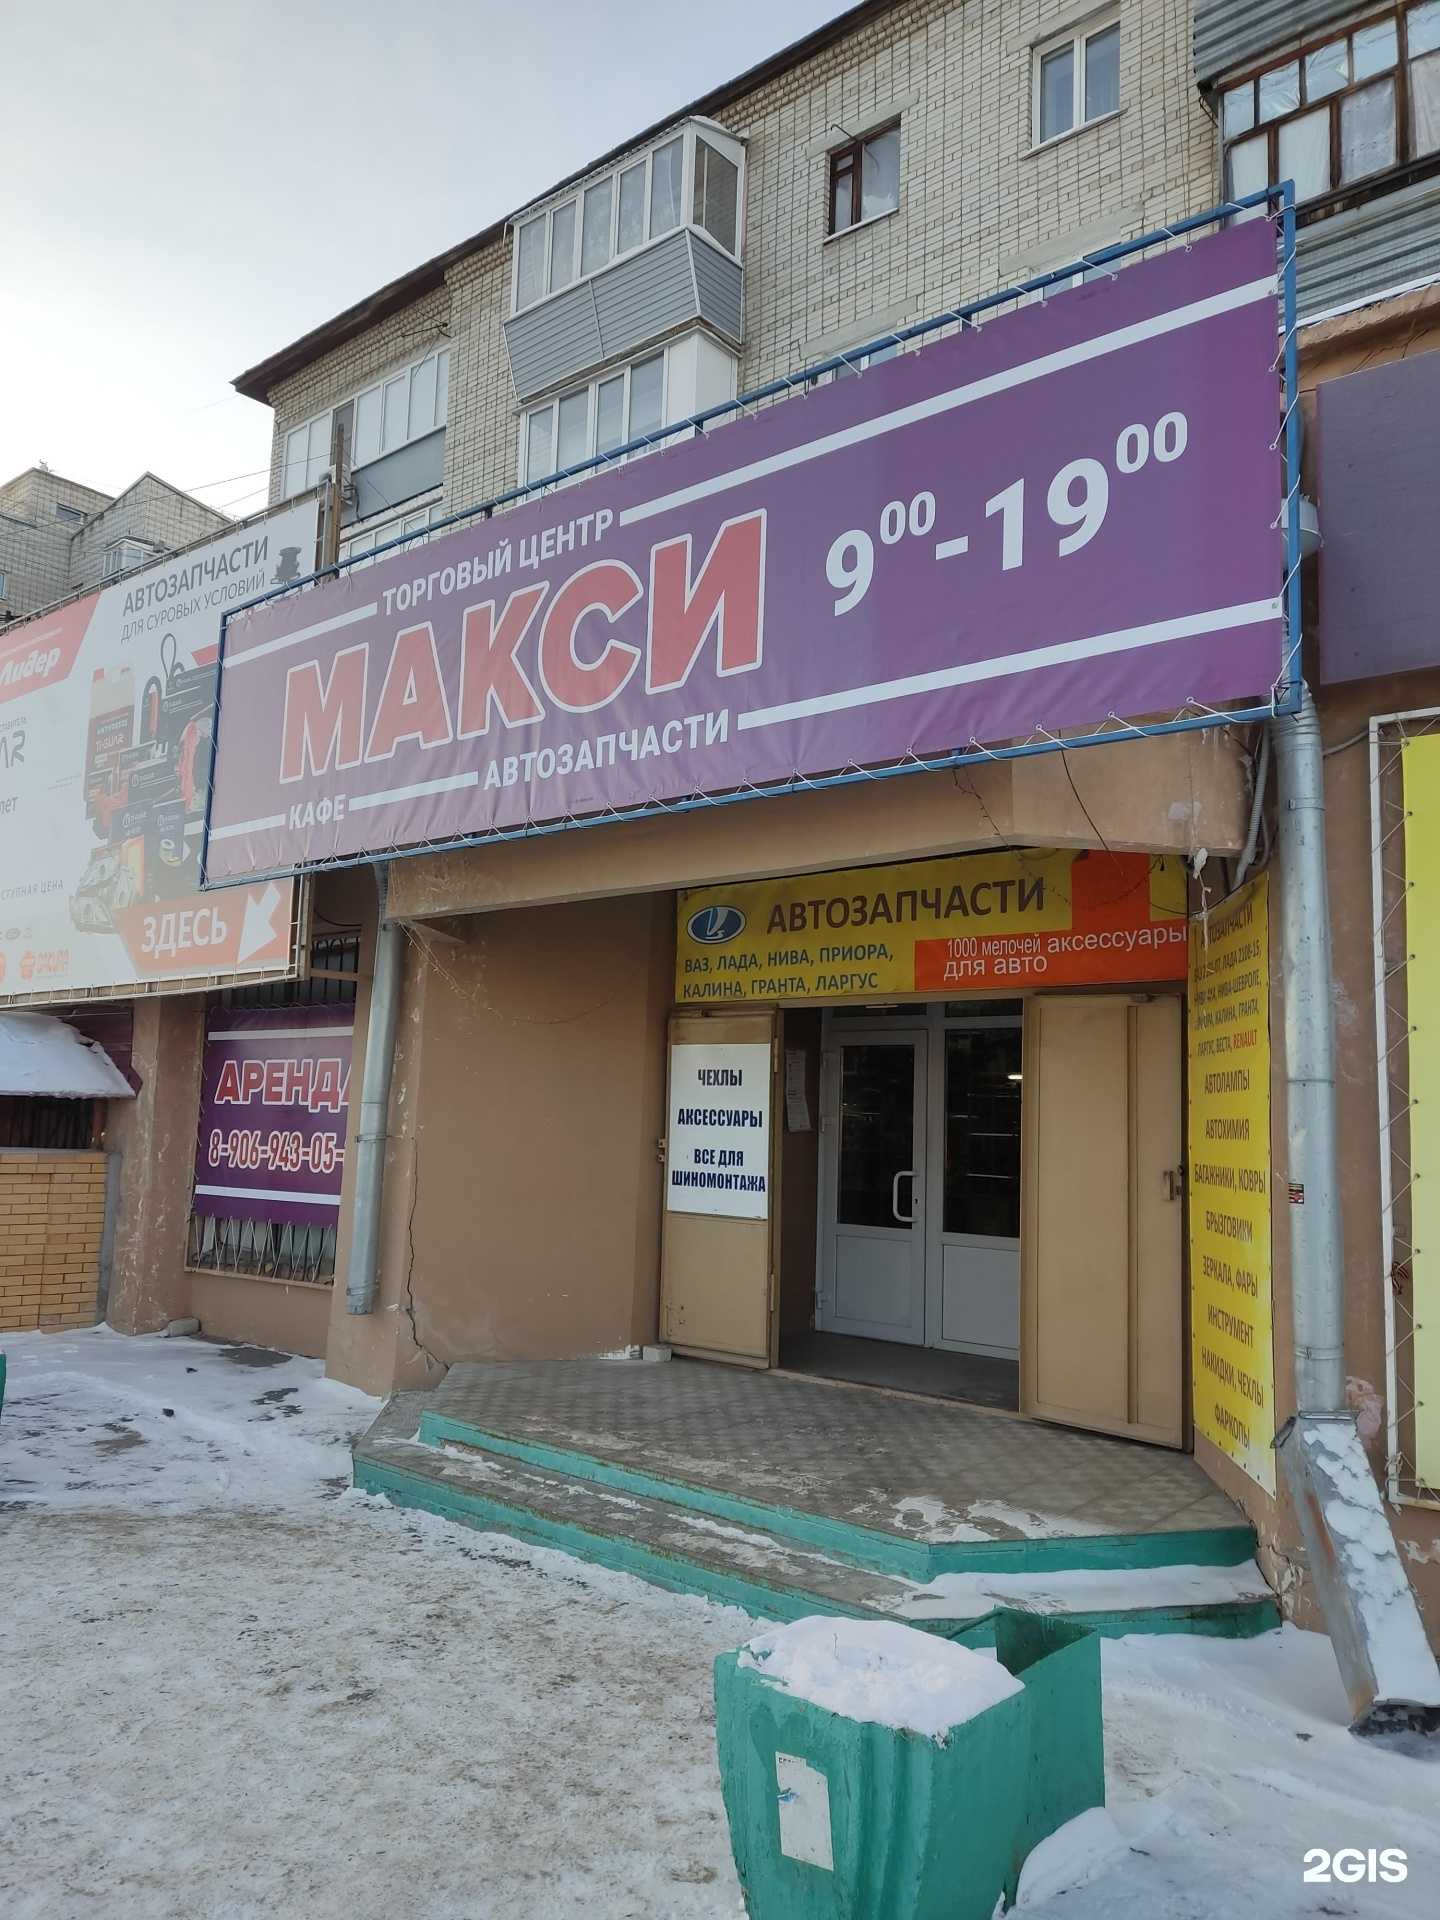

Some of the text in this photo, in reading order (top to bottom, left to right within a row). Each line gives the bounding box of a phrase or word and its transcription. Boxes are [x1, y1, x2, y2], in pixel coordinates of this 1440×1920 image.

[123, 536, 268, 616] АВТОЗАПЧАСТИ
[382, 508, 614, 616] ТОРГОВЫЙ ЦЕНТР
[120, 568, 265, 644] ДЛЯ СУРОВЫХ УСЛОВИЙ
[279, 508, 767, 784] МАКСИ
[484, 708, 729, 790] АВТОЗАПЧАСТИ
[288, 793, 346, 831] КАФЕ
[767, 876, 1044, 935] АВТОЗАПЧАСТИ
[141, 906, 228, 959] ЗДЕСЬ
[947, 925, 1188, 959] 1000 мелочей аксессуары
[685, 943, 893, 974] ВАЗ, ЛАДА, НИВА, ПРИОРА,
[944, 955, 1048, 981] для авто
[683, 972, 878, 998] КАЛИНА, ГРАНТА, ЛАРГУС
[698, 1069, 743, 1086] ЧЕХЛЫ
[1205, 1068, 1249, 1094] АВТОЛАМПЫ
[677, 1108, 763, 1128] АКСЕССУАРЫ
[1206, 1119, 1249, 1141] АВТОХИМИЯ
[694, 1148, 744, 1168] ВСЕ ДЛЯ
[672, 1170, 766, 1192] ШИНОМОНТАЖА
[1194, 1163, 1266, 1194] БАГАЖНИКИ, КОВРЫ
[1206, 1210, 1252, 1242] БРЫЗГОВИКИ
[1203, 1256, 1258, 1298] ЗЕРКАЛА, ФАРЫ
[1207, 1304, 1254, 1348] ИНСТРУМЕНТ
[1201, 1345, 1264, 1408] НАКИДКИ, ЧЕХЛЫ
[1214, 1402, 1250, 1450] ФАРКОПЫ
